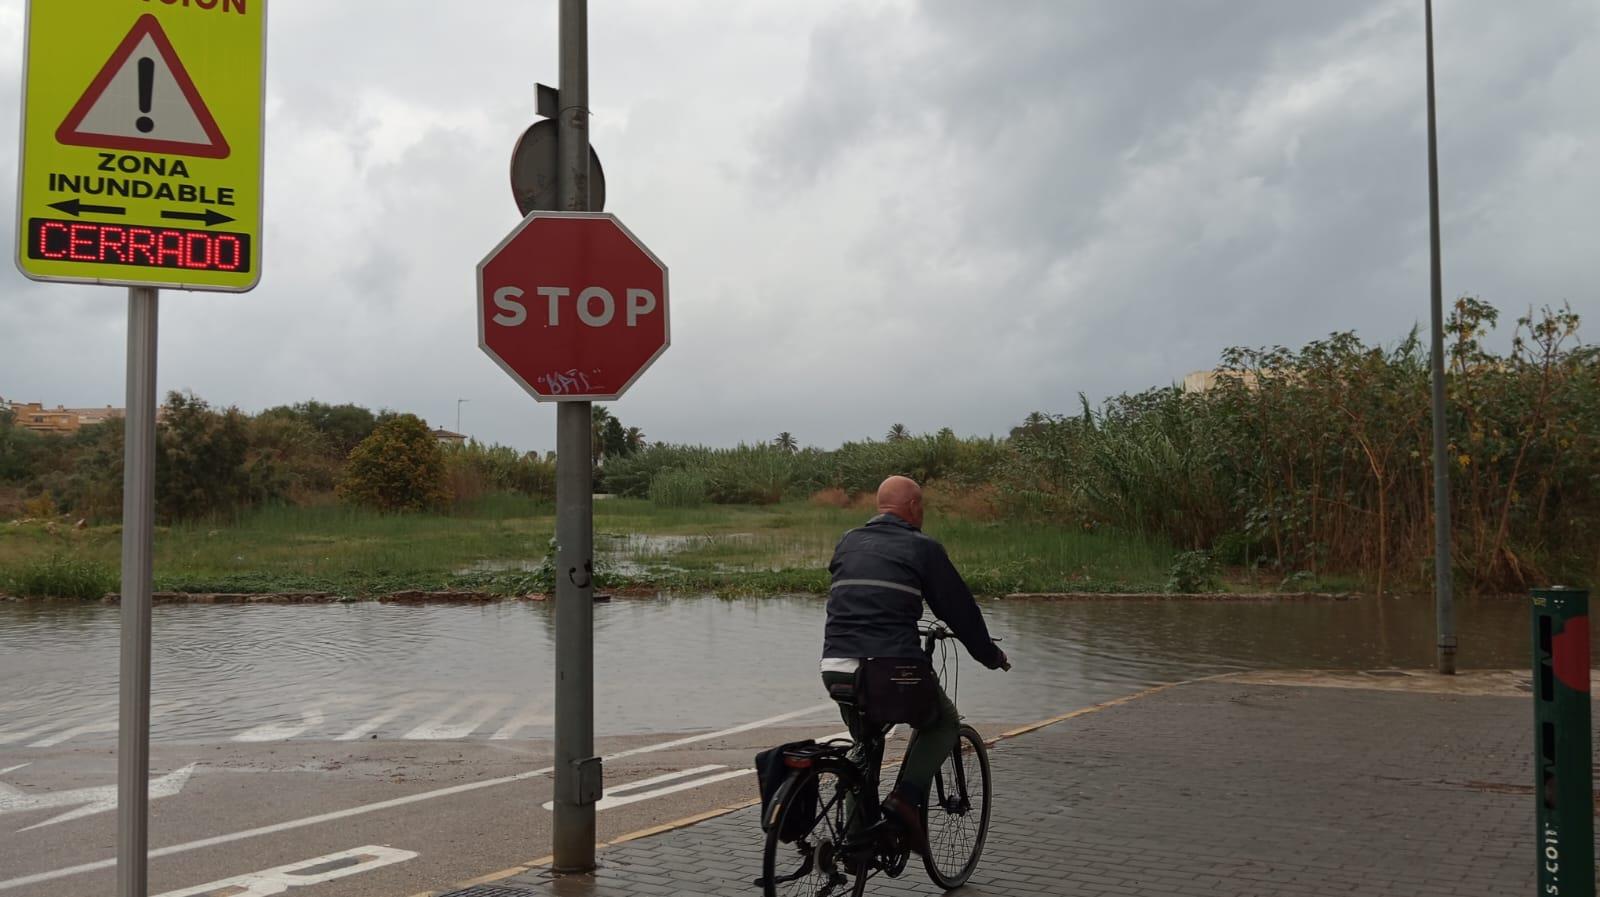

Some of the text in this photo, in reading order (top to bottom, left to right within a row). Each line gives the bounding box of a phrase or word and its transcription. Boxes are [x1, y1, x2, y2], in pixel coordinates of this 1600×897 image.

[97, 152, 190, 178] ZONA
[48, 173, 236, 206] INUNDABLE
[40, 221, 241, 270] CERRADO
[492, 286, 657, 327] STOP
